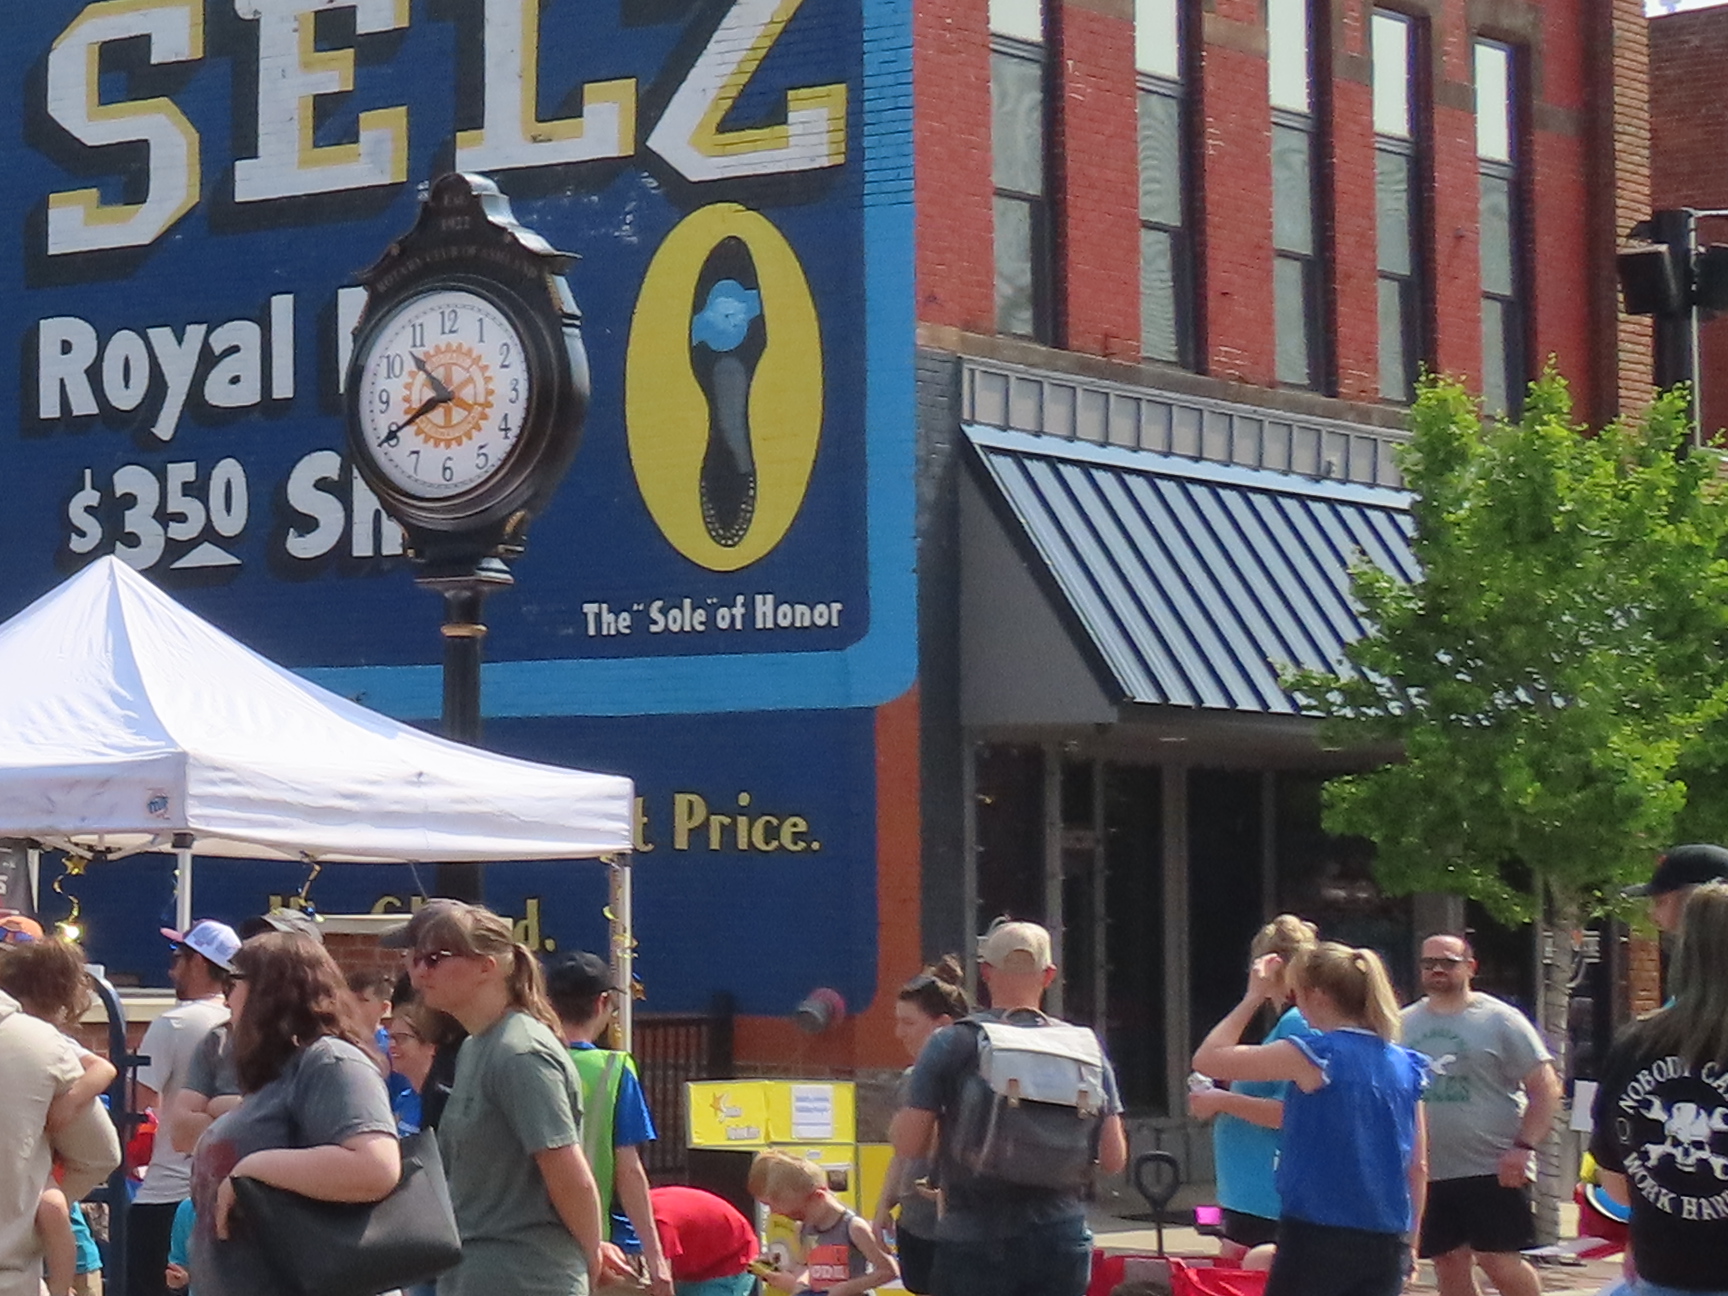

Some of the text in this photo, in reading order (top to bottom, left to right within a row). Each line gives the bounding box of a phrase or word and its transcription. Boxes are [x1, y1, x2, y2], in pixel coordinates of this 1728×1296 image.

[440, 308, 460, 335] 12
[477, 317, 487, 344] 1
[410, 322, 426, 348] 11
[38, 292, 295, 441] Royal
[385, 353, 405, 379] 10
[499, 344, 511, 369] 2
[378, 390, 390, 414] 9
[508, 378, 520, 403] 3
[498, 414, 511, 439] 4
[407, 450, 421, 475] 7
[441, 456, 454, 482] 6
[475, 443, 489, 469] 5
[582, 602, 632, 636] The
[716, 594, 746, 630] of
[754, 593, 843, 629] Honor
[673, 791, 821, 852] Price.
[1622, 1151, 1678, 1215] WORK
